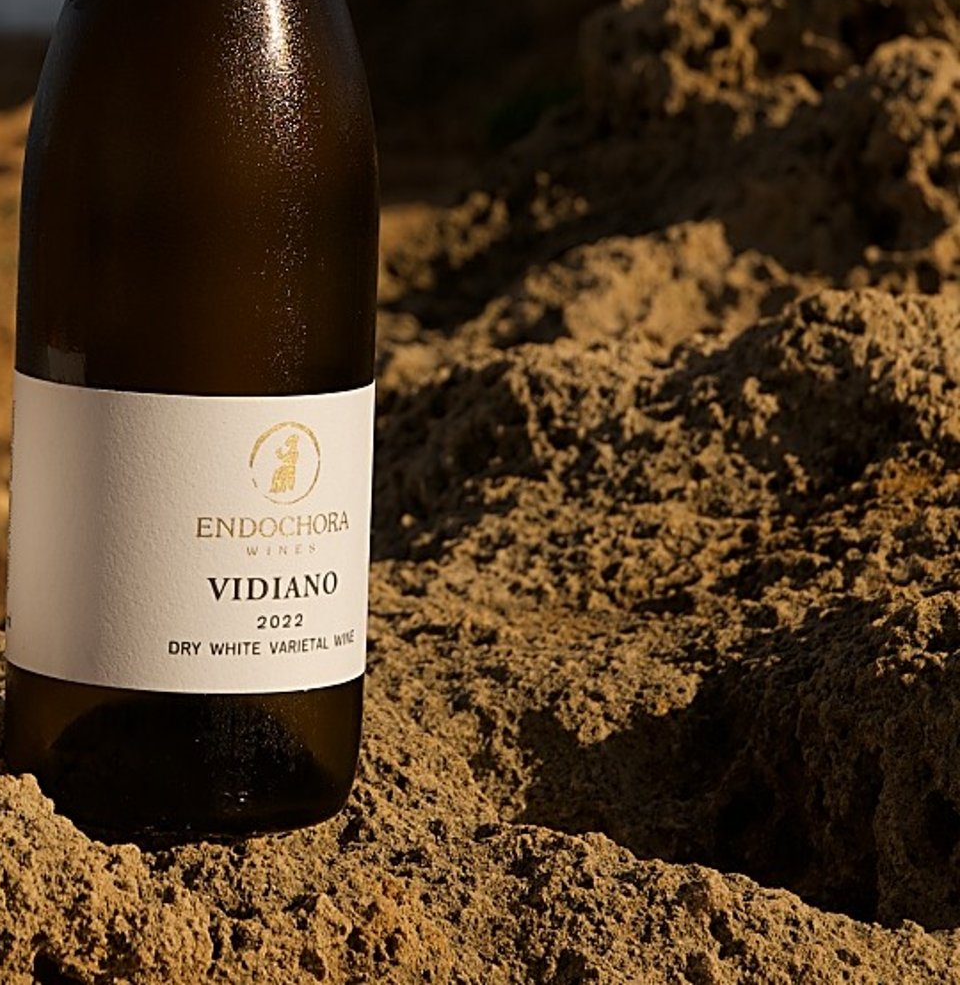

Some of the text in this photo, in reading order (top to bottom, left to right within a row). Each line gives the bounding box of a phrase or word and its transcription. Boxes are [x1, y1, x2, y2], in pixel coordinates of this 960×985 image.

[195, 511, 349, 538] ENDOCHORA
[246, 545, 317, 556] WINES
[207, 570, 338, 600] VIDIANO
[256, 613, 303, 629] 2022
[168, 629, 354, 655] DRY WHITE VARIETAL WINE
